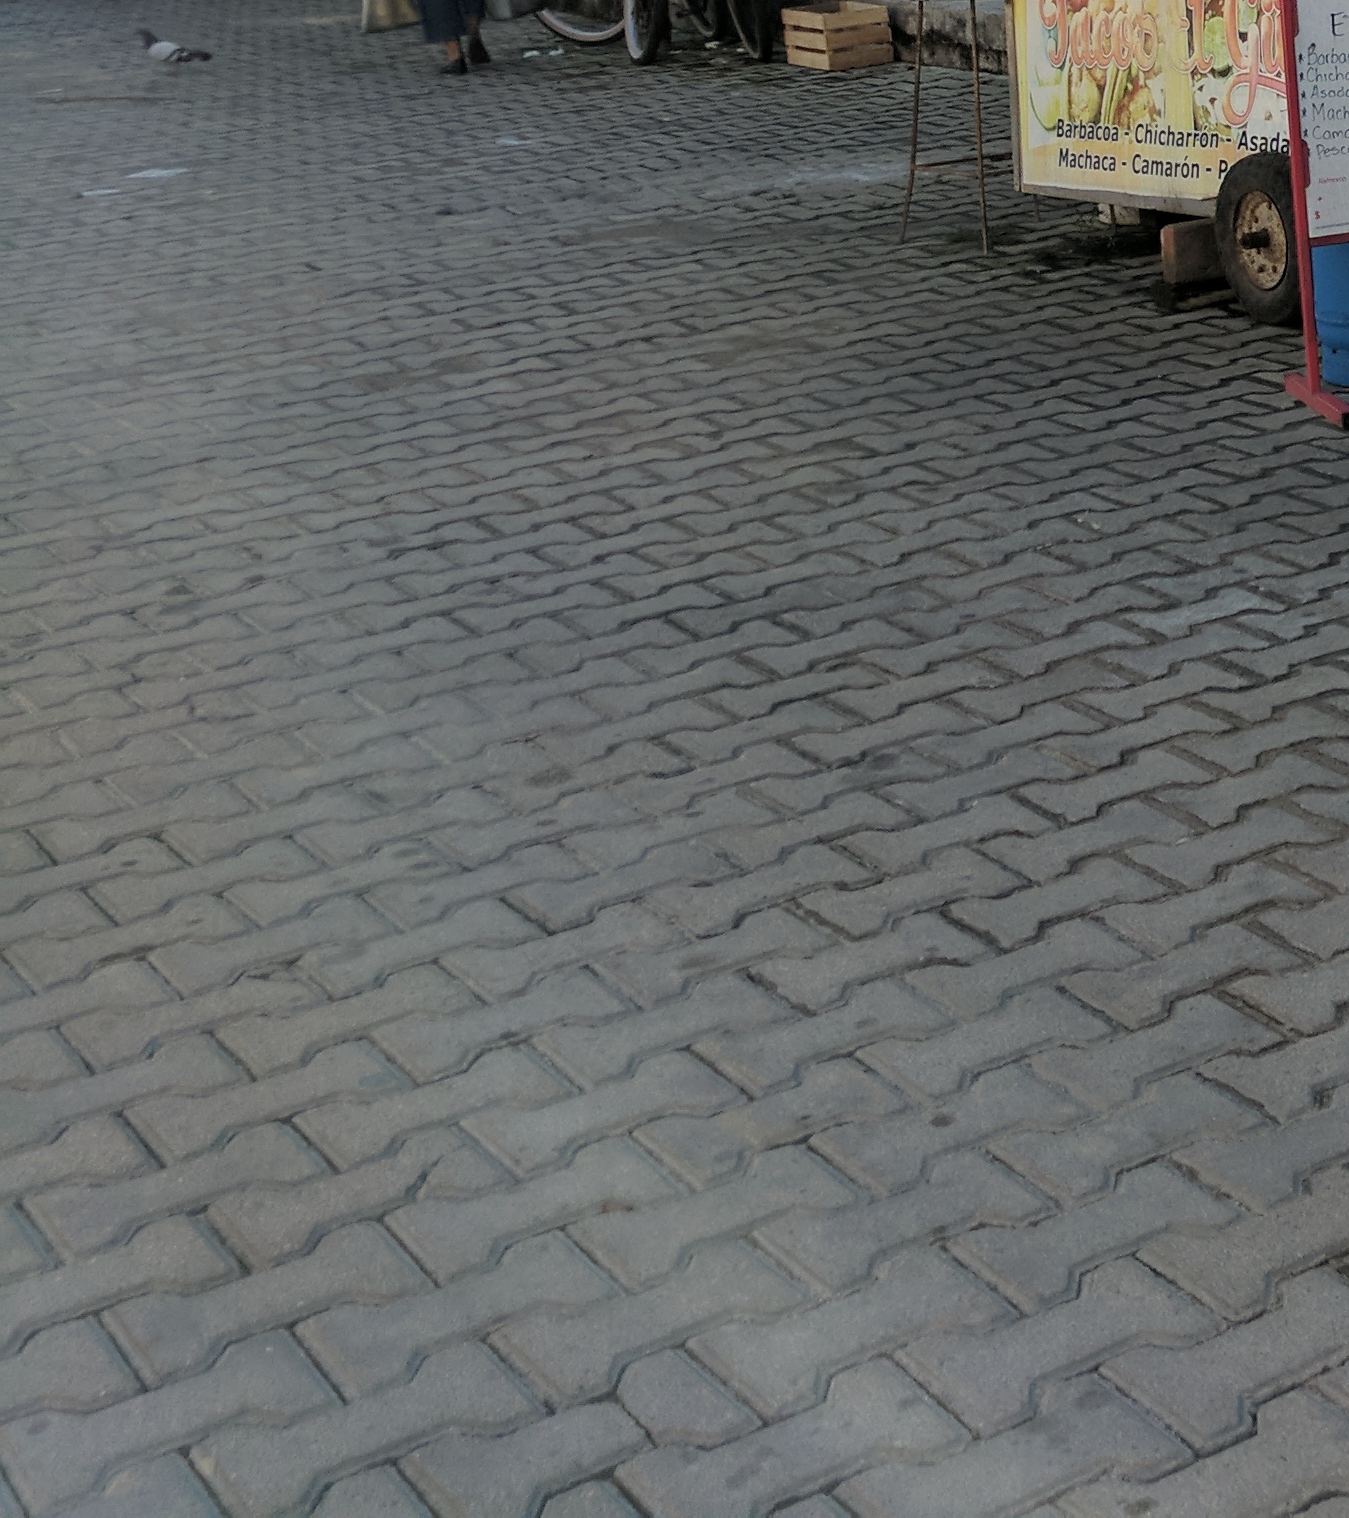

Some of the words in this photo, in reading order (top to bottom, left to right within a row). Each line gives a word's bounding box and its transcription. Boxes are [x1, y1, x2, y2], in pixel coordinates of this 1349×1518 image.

[1056, 118, 1120, 143] Barbacoa
[1134, 123, 1220, 149] Chicharrón
[1236, 131, 1291, 155] Asada
[1058, 147, 1117, 172] Machaca
[1132, 154, 1200, 180] Camarón
